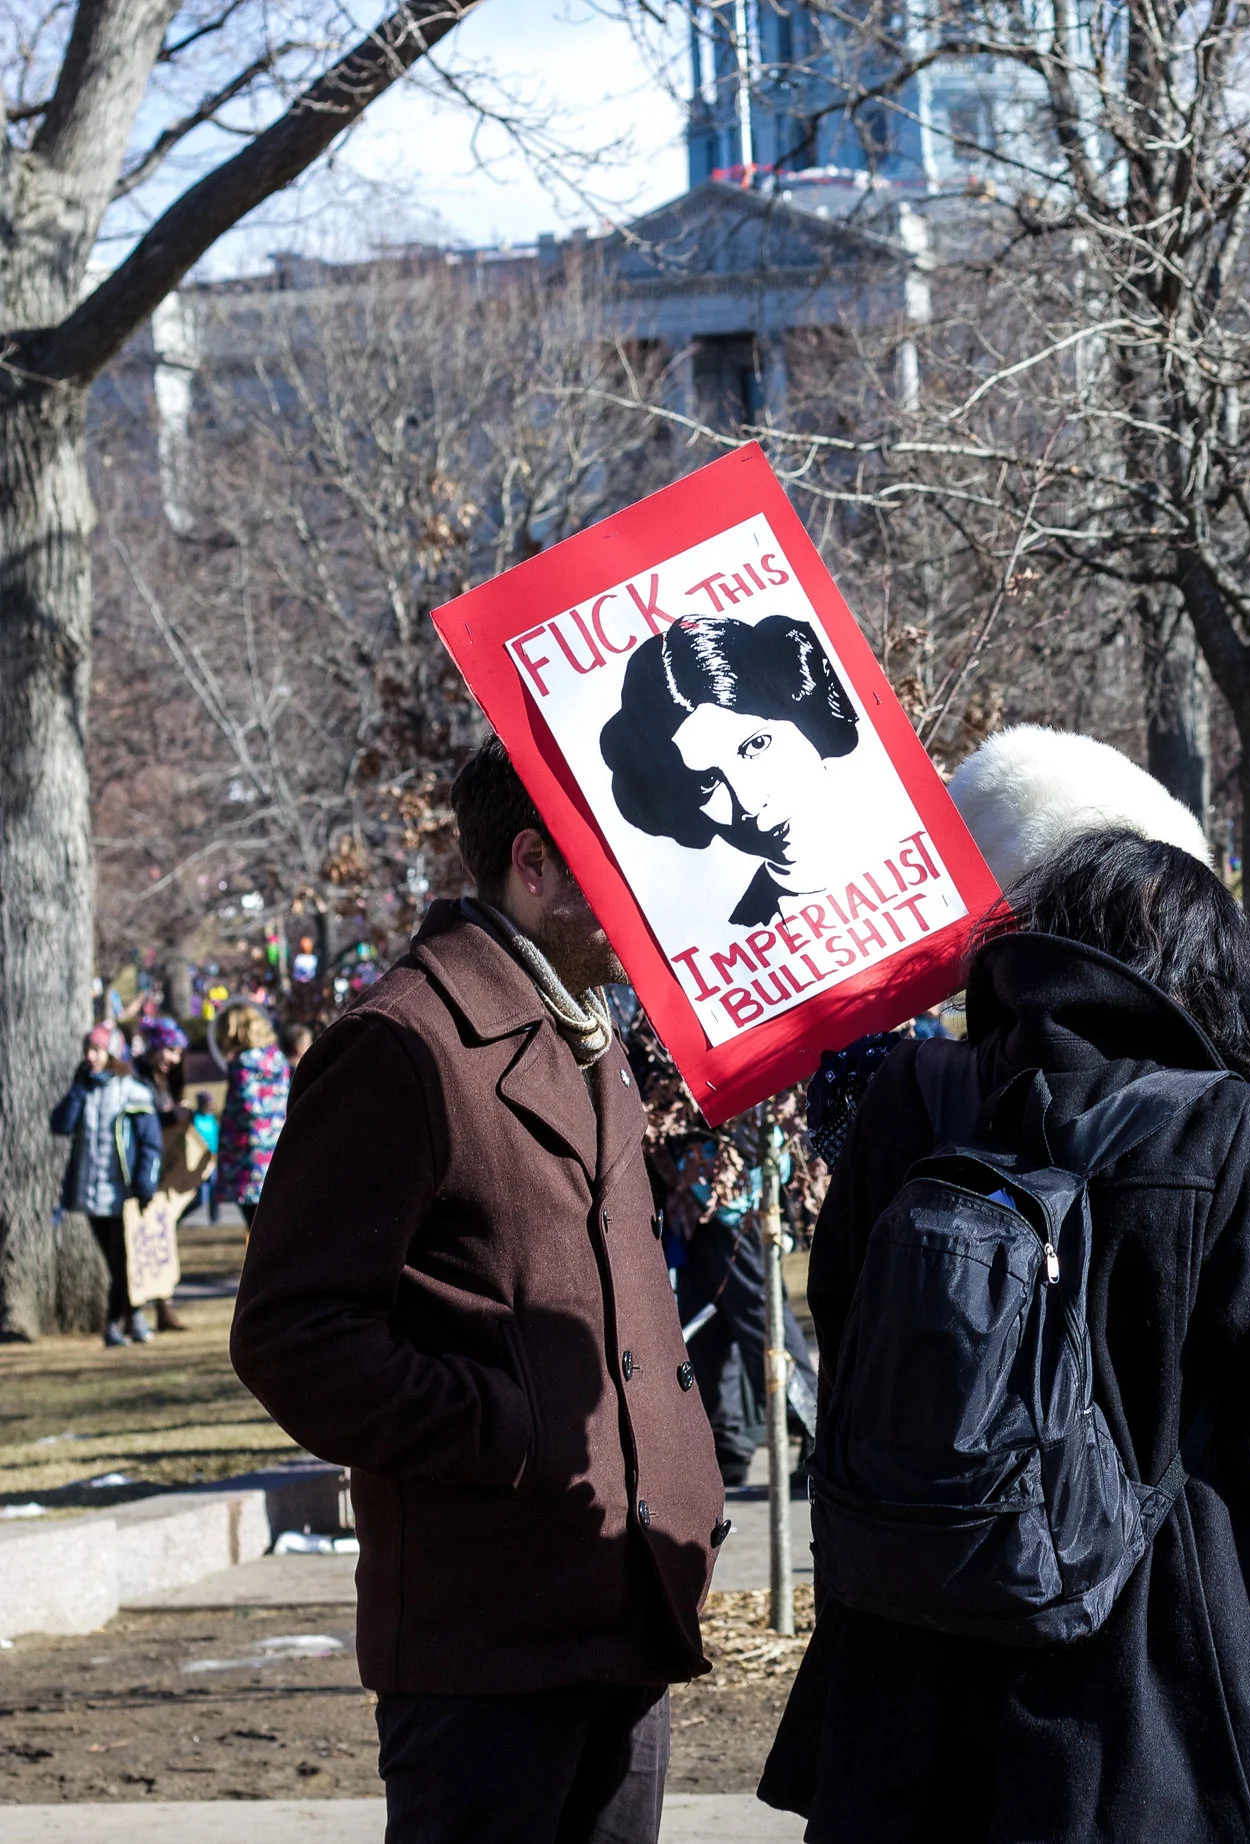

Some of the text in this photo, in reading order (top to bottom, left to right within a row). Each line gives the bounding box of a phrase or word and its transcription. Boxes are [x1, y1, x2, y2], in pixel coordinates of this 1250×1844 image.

[510, 553, 789, 697] FUCK THIS
[671, 830, 941, 1002] IMPERIALIST
[718, 893, 930, 1028] BULLSHIT
